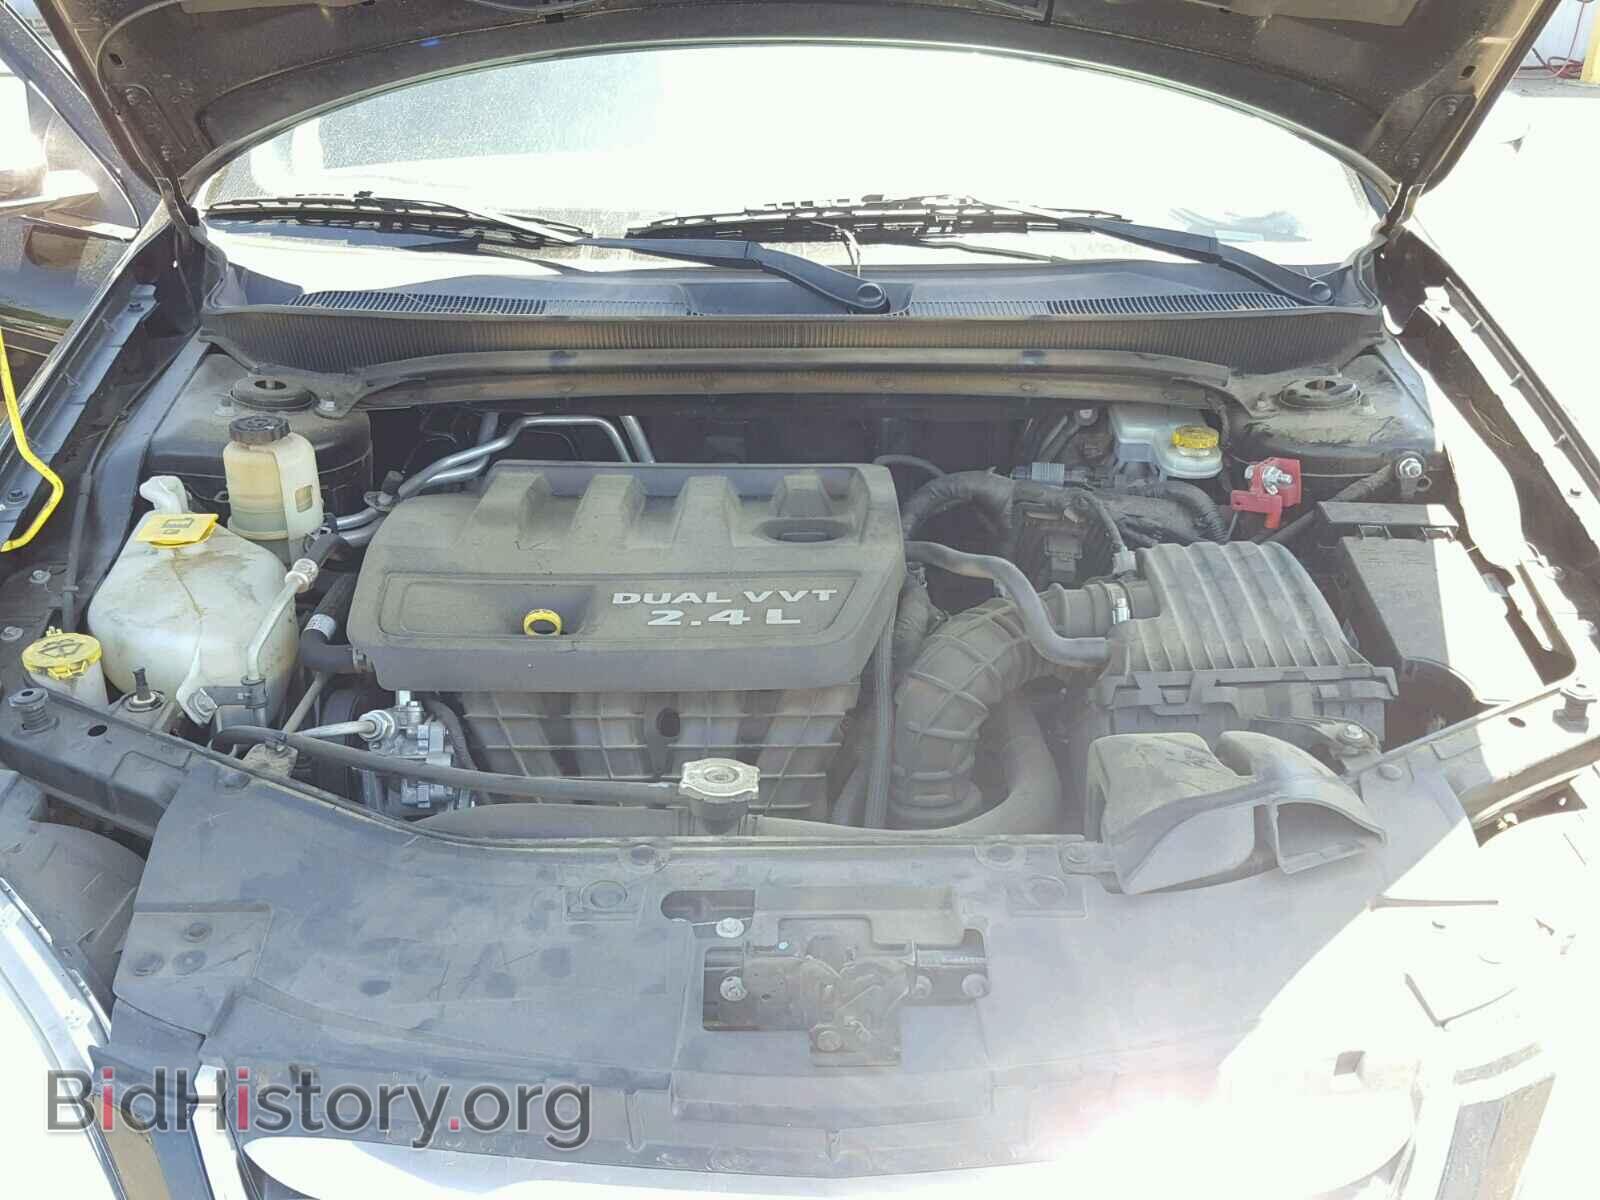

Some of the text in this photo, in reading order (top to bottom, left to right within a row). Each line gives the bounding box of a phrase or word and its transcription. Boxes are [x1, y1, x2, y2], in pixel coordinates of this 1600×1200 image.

[611, 589, 838, 605] DUAL VVT
[647, 608, 801, 626] 2.4 L
